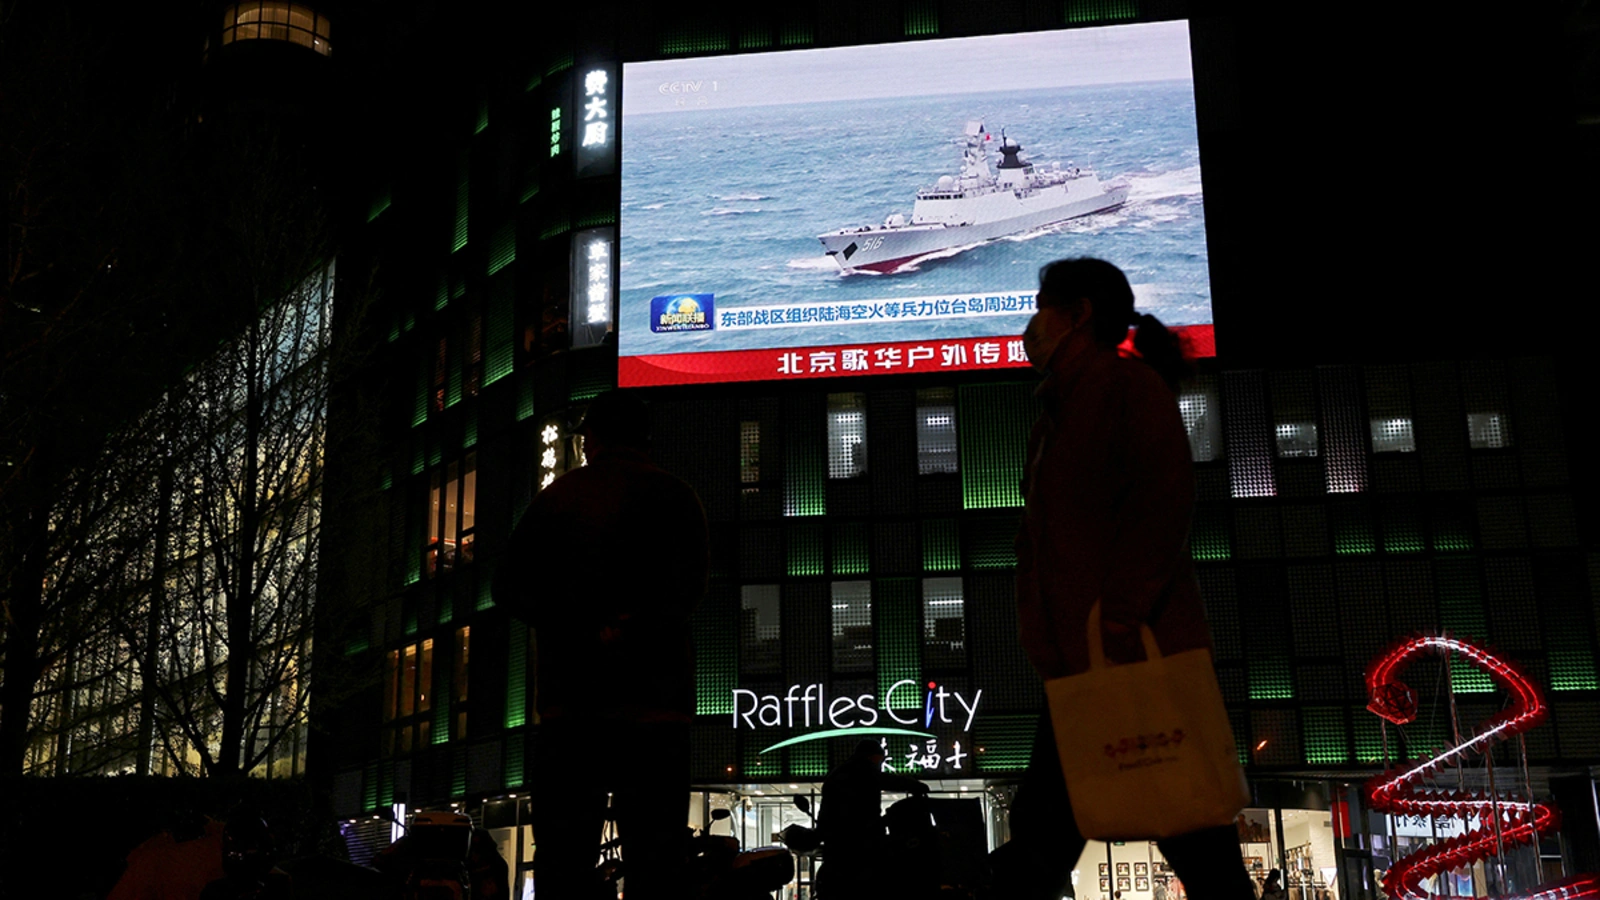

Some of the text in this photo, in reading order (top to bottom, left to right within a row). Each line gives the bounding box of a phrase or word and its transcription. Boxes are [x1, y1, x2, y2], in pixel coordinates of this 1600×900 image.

[658, 80, 703, 95] CCTV
[582, 69, 609, 147] 费大厨
[862, 236, 885, 252] 516
[721, 295, 1034, 327] 东部战区组织陆海空火等兵力位台岛周边开
[733, 679, 982, 731] Raffles City
